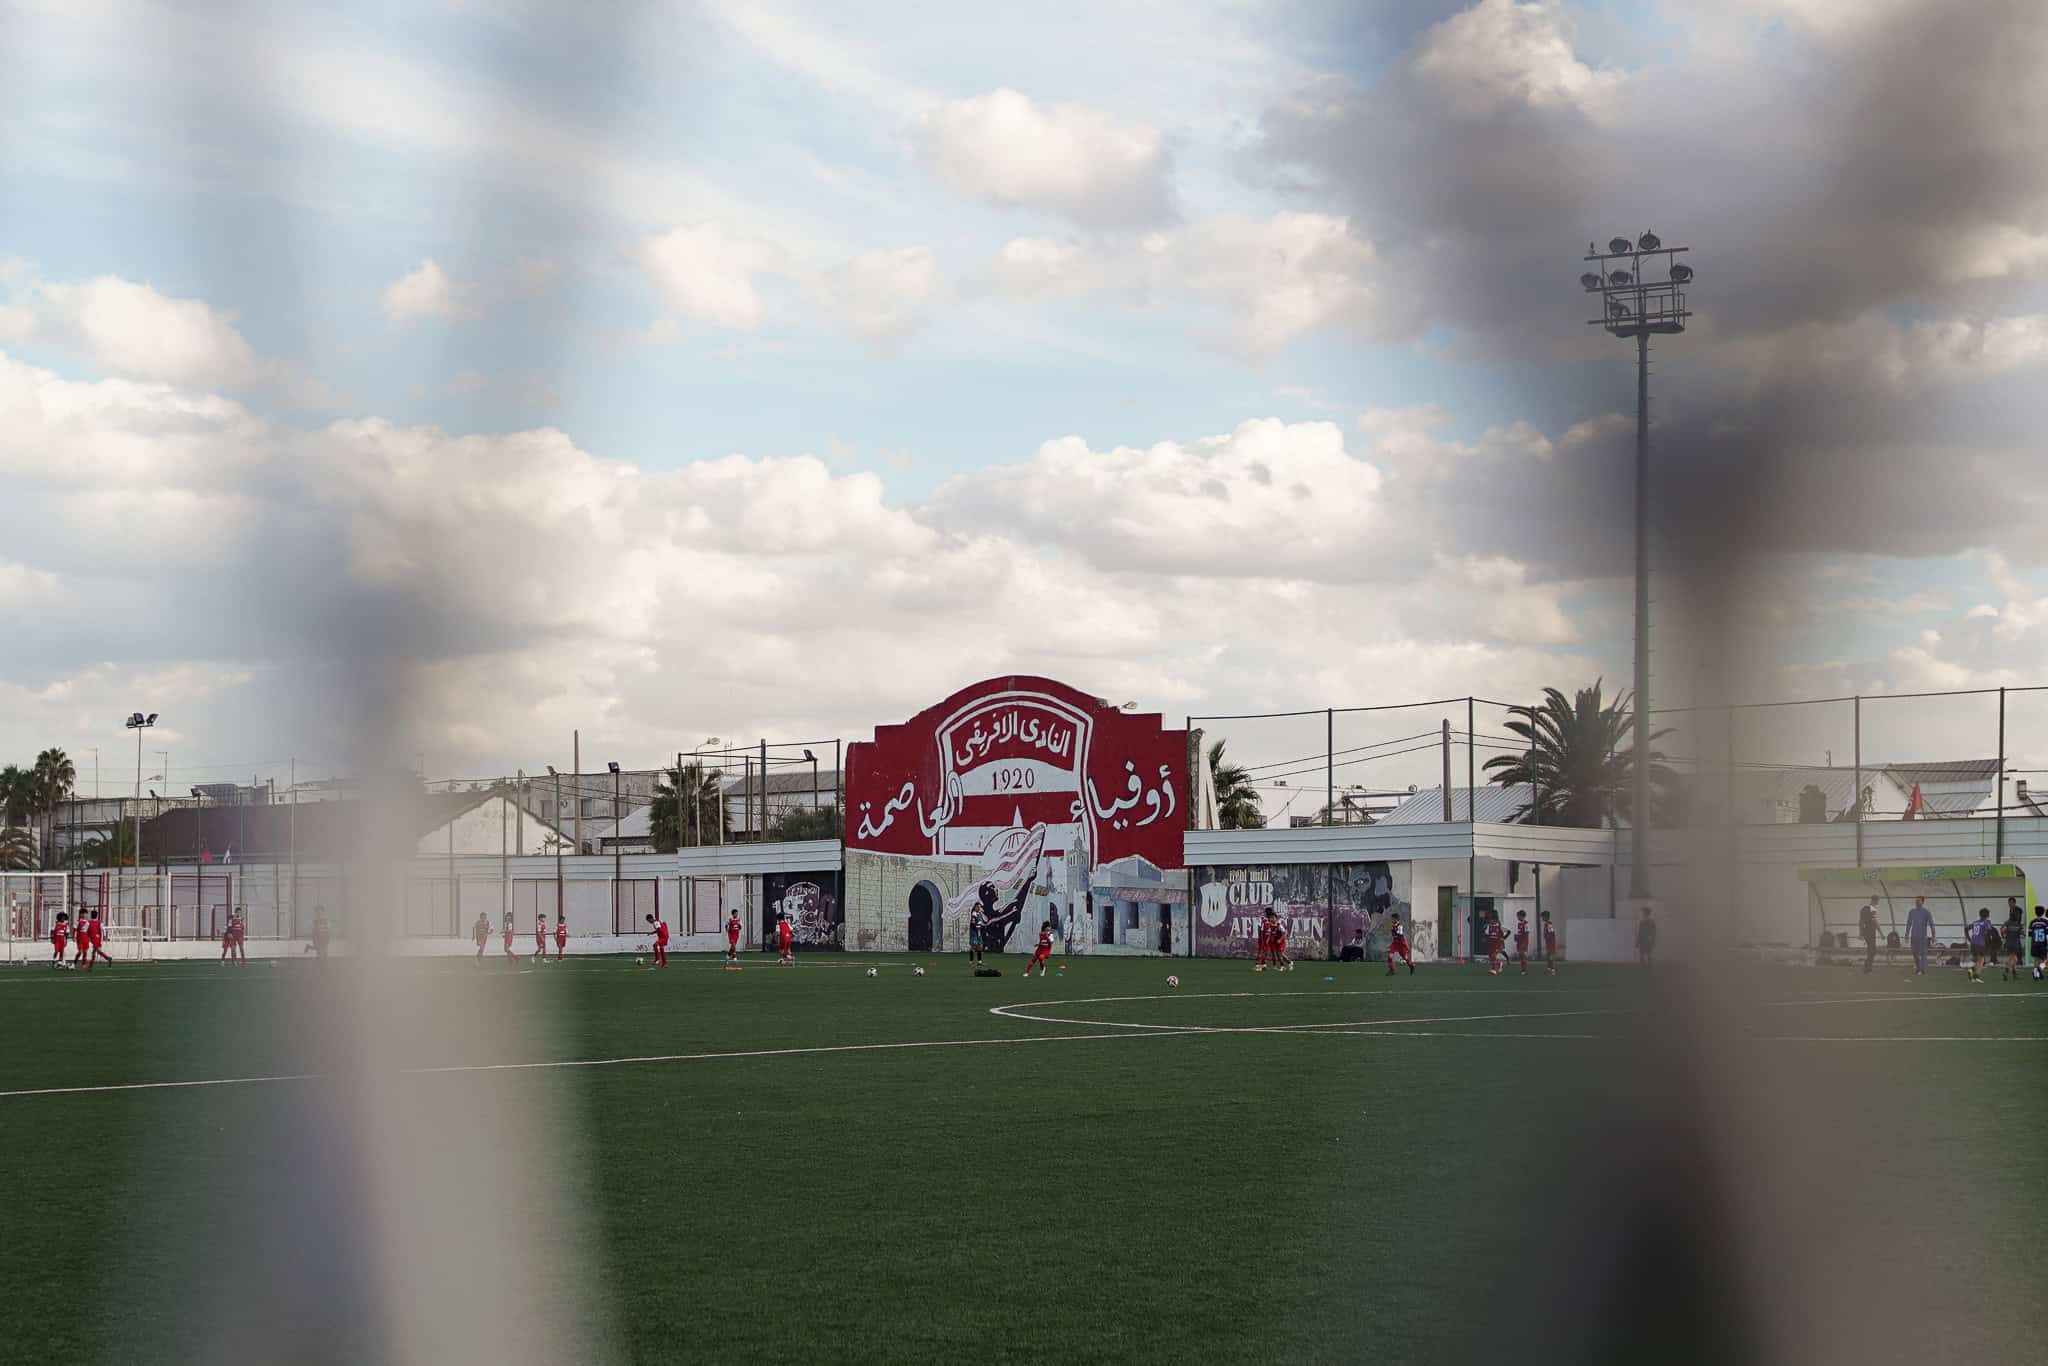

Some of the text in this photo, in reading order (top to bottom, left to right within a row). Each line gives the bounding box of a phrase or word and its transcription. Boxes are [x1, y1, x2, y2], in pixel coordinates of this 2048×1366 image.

[991, 767, 1035, 791] 1920
[1229, 882, 1275, 906] CLUB
[2033, 928, 2046, 943] 15
